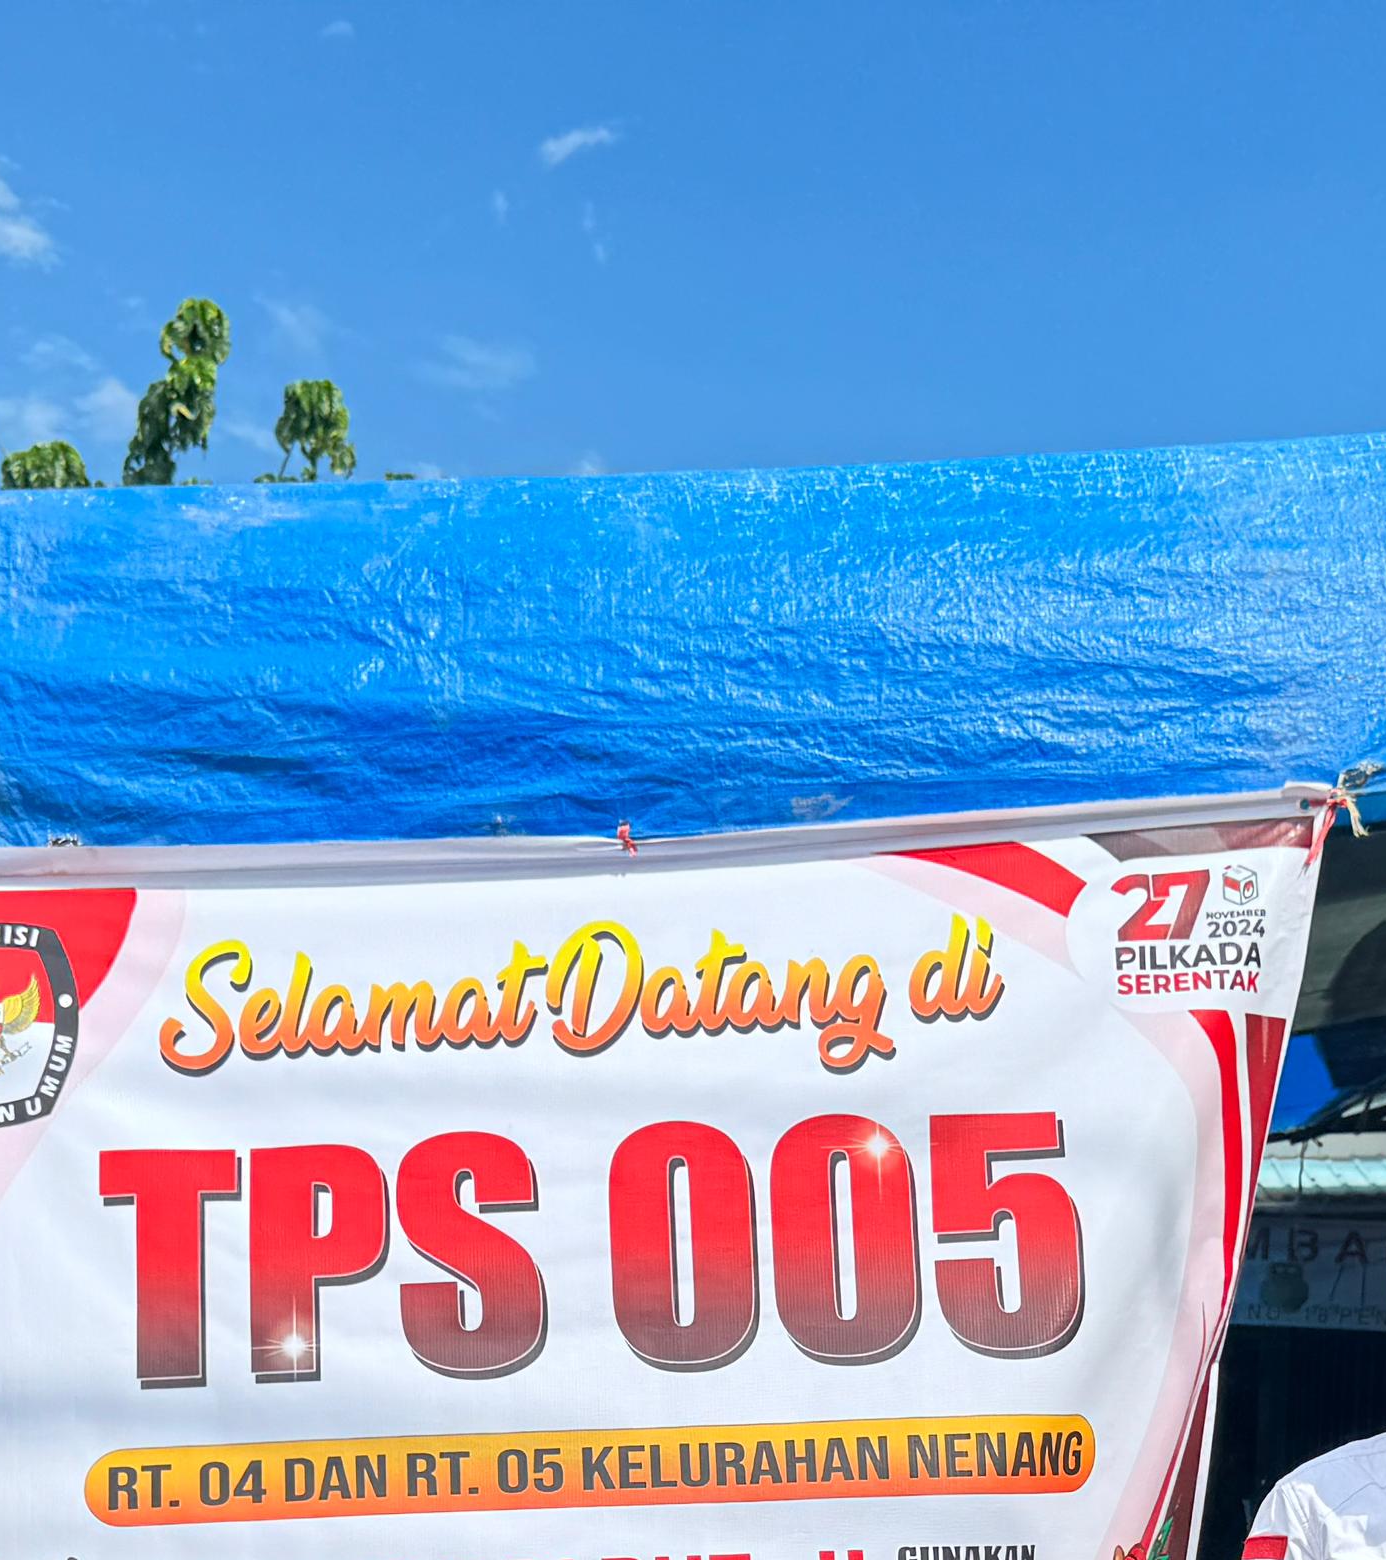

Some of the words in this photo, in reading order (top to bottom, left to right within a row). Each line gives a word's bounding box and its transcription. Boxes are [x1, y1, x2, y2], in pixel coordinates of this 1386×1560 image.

[1111, 869, 1210, 941] 27
[1208, 919, 1265, 938] 2024
[1115, 942, 1261, 970] PILKADA
[1117, 970, 1260, 995] SERENTAK
[159, 939, 546, 1075] Selamat
[545, 920, 896, 1074] Datang
[908, 914, 1005, 1020] di
[25, 1035, 74, 1116] UMUM
[99, 1131, 548, 1390] TPS
[609, 1111, 1084, 1373] 005
[108, 1464, 180, 1510] RT.
[199, 1459, 266, 1505] 04
[285, 1454, 387, 1502] DAN
[407, 1451, 479, 1497] RT.
[497, 1448, 564, 1493] 05
[582, 1433, 892, 1490] KELURAHAN
[907, 1431, 1082, 1480] NENANG
